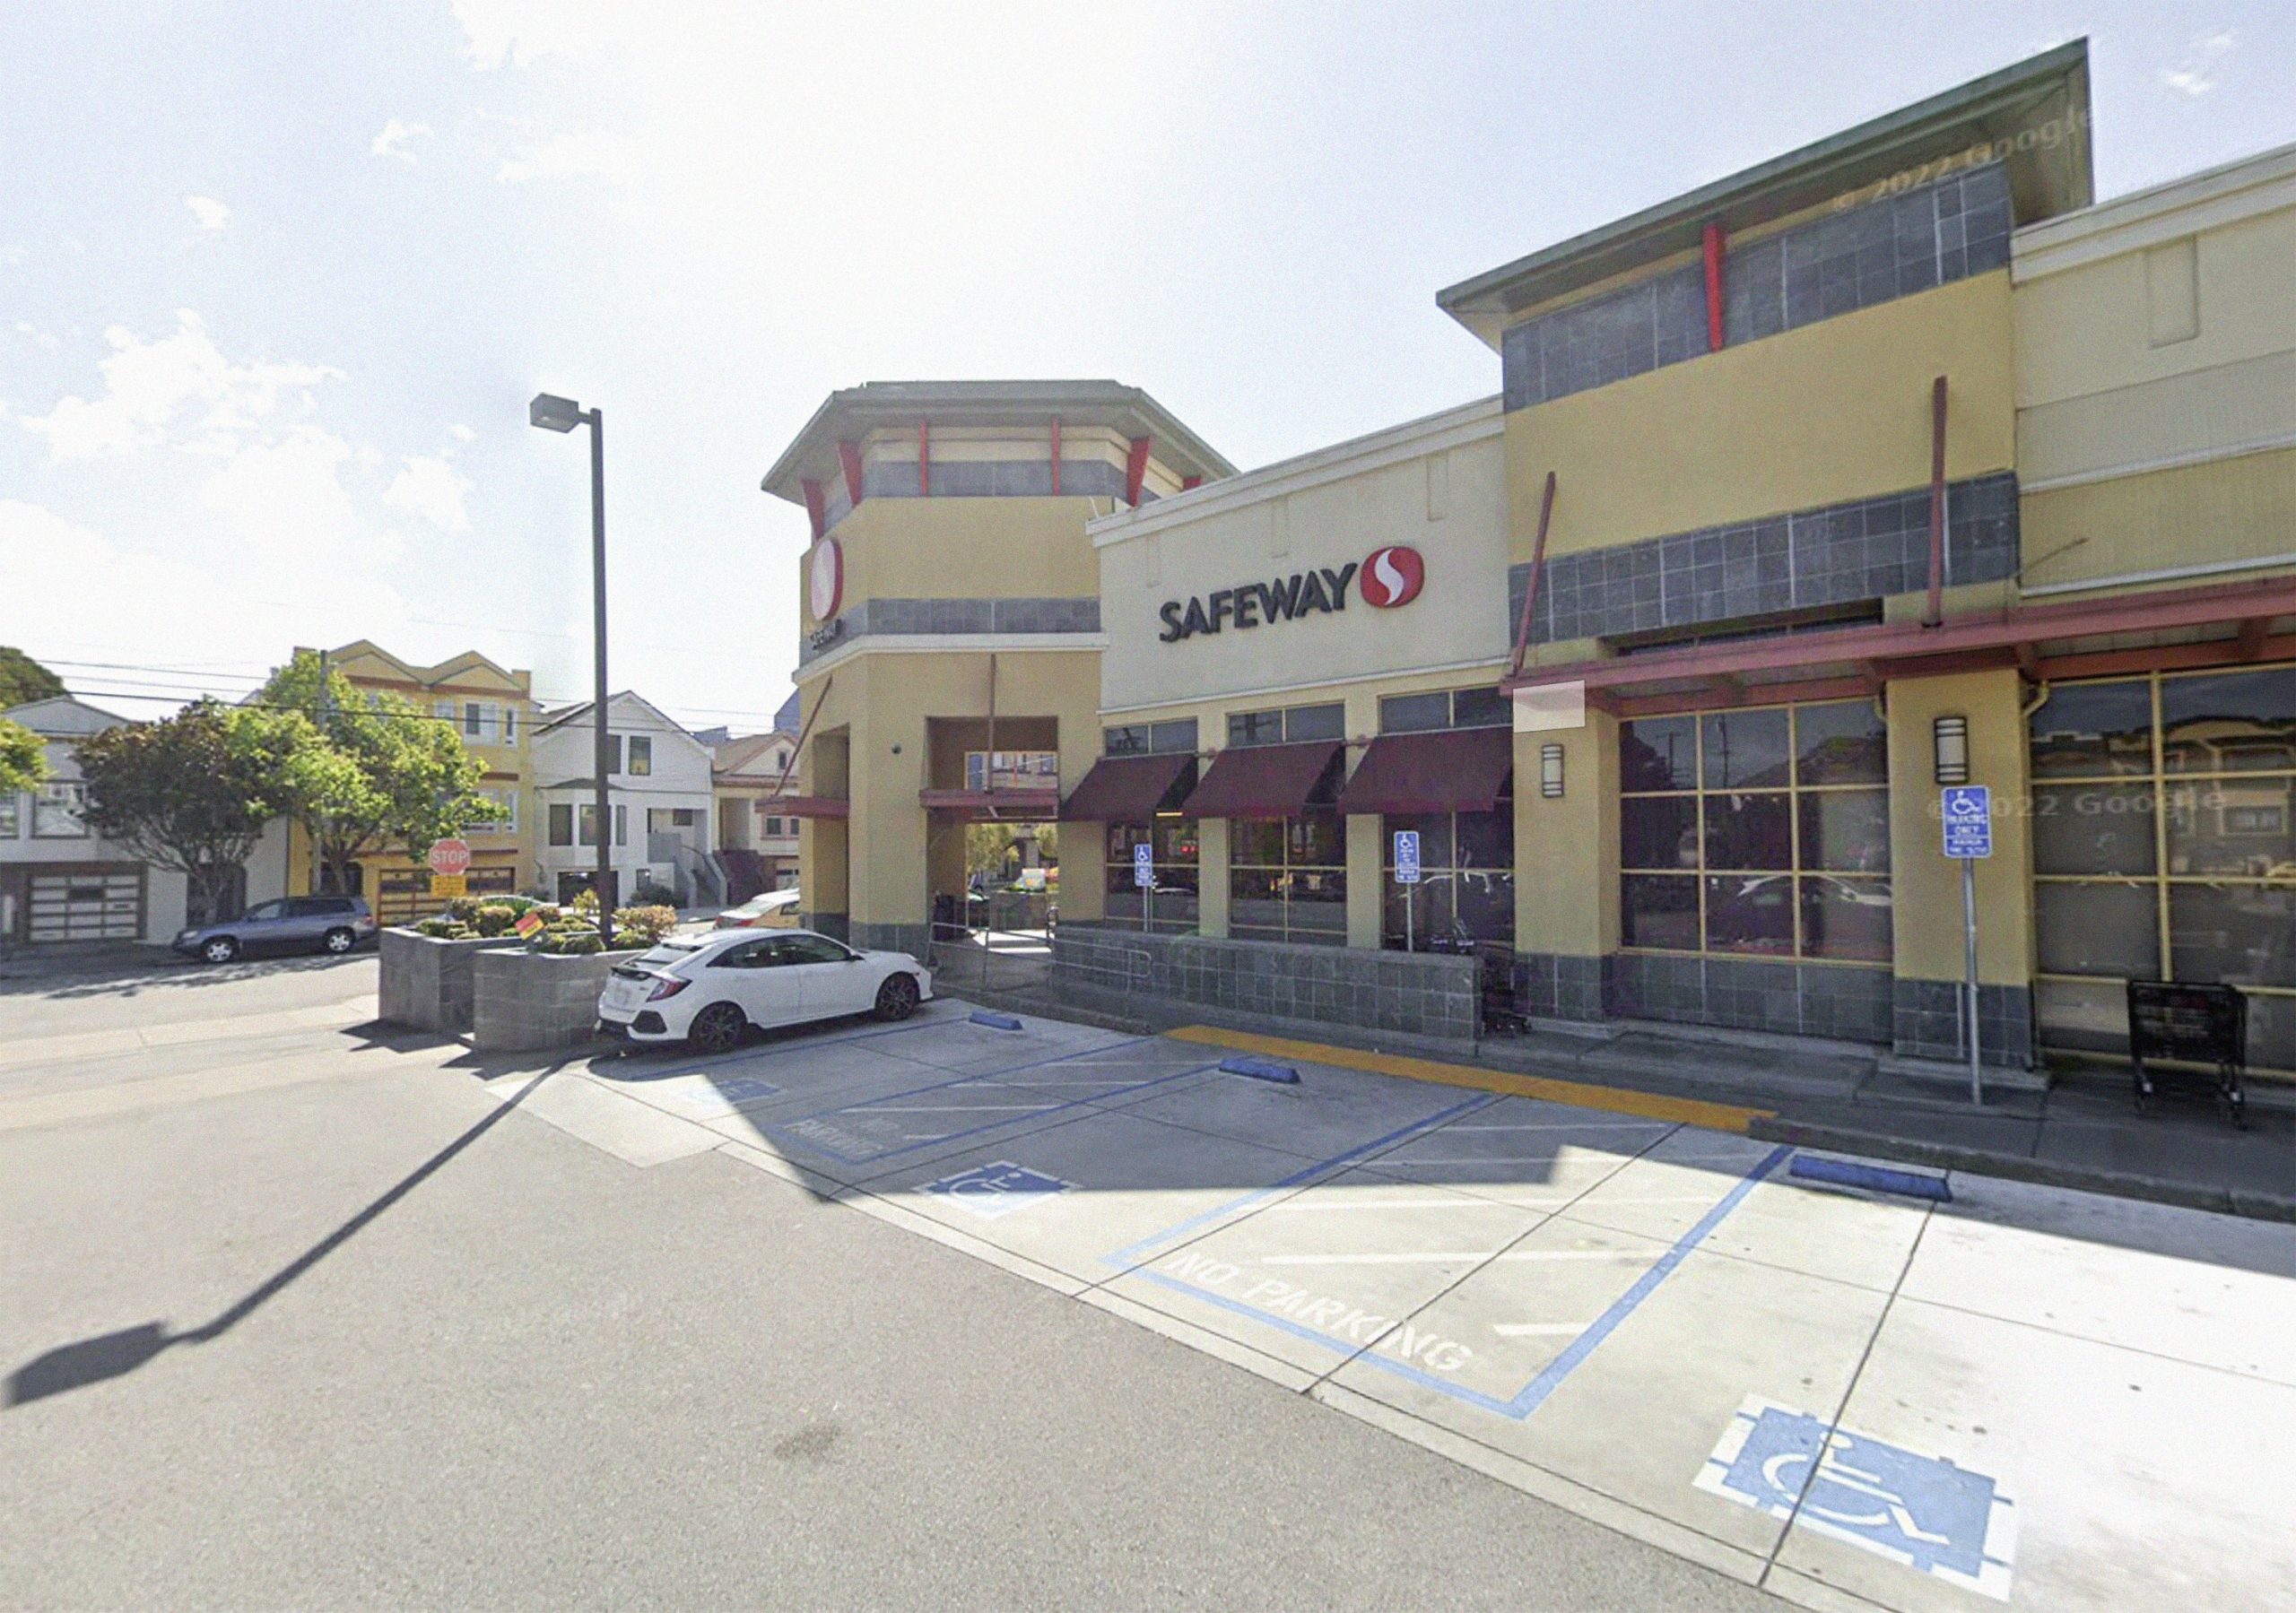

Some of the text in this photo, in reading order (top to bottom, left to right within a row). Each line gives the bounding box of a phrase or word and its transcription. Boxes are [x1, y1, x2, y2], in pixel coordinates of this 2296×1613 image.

[1159, 562, 1358, 643] SAFEWAY
[432, 850, 466, 865] STOP
[1166, 1253, 1473, 1371] NO PARKING
